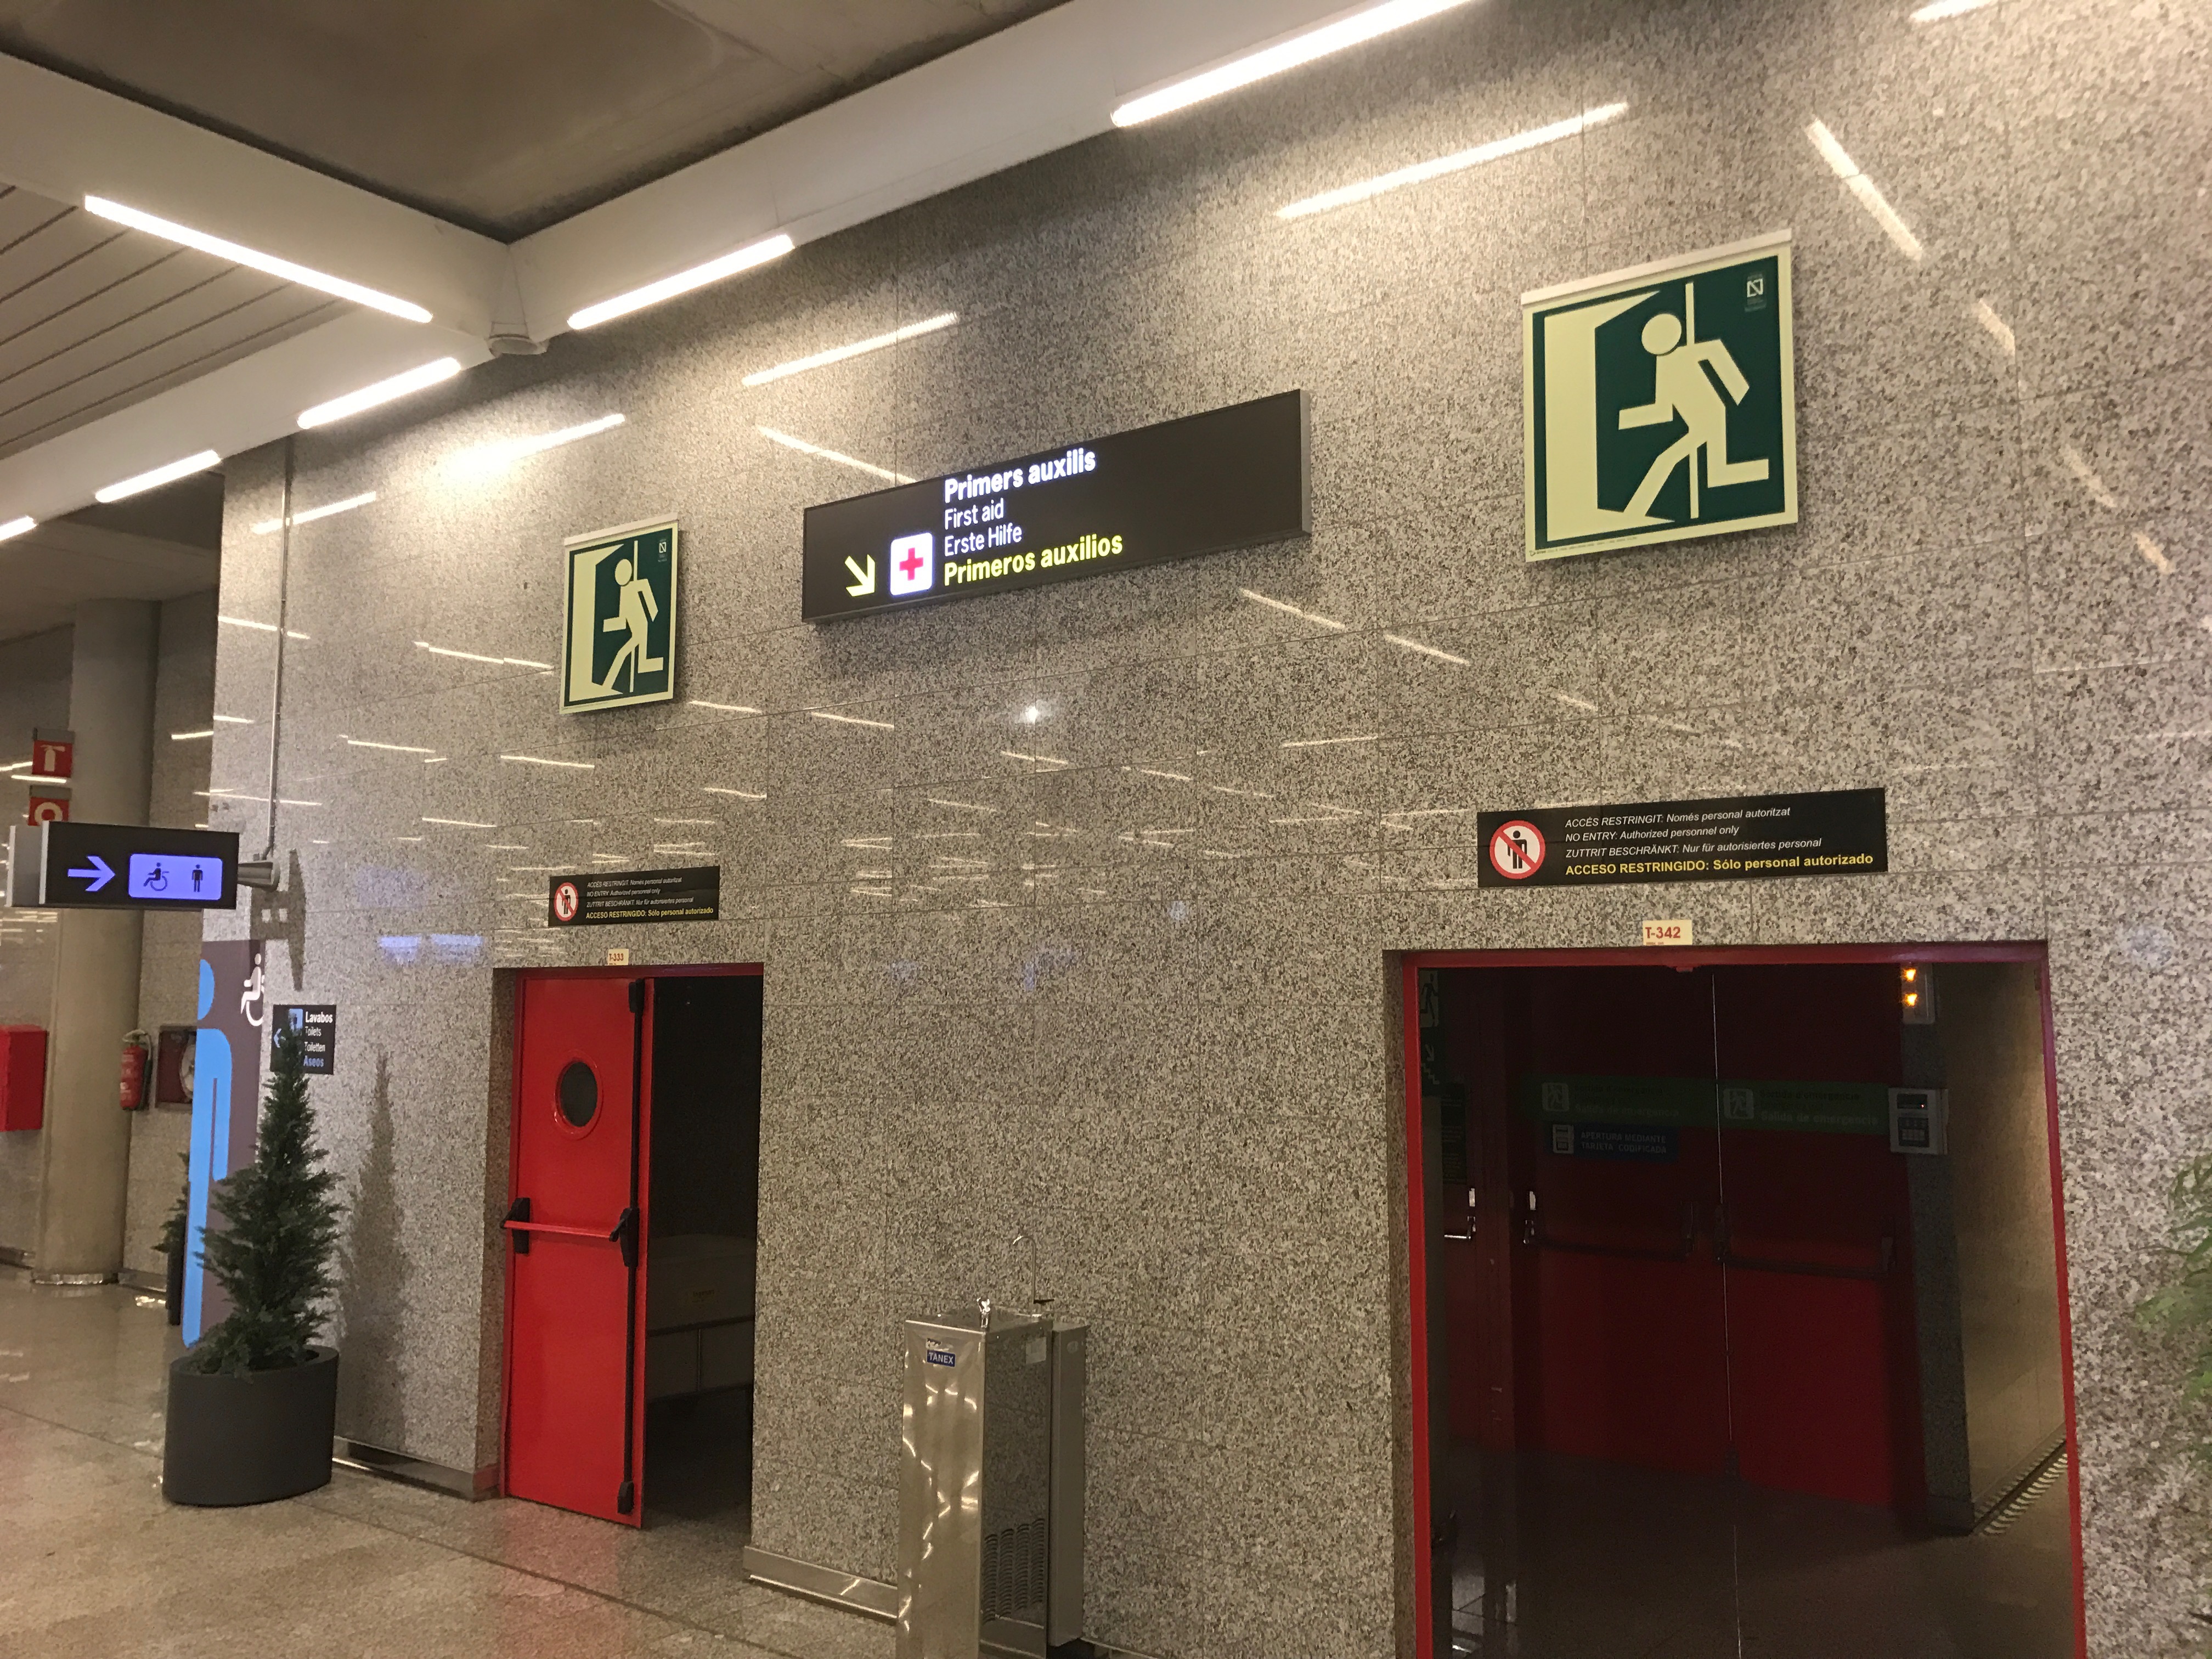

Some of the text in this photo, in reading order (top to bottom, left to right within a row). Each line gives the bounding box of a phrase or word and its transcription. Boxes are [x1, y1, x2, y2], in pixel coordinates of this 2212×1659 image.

[944, 448, 1096, 503] Primers auxilis
[945, 498, 1004, 530] First aid
[945, 522, 1023, 557] Erste Hilfe
[944, 533, 1123, 586] Primeros auxilios
[1666, 811, 1699, 823] Només
[1701, 810, 1743, 823] personal
[1745, 808, 1791, 819] autoritzat
[1565, 826, 1739, 842] NO ENTRY: Authorized personnel only
[1566, 848, 1607, 858] ZUTTRIT
[1682, 844, 1700, 853] Nur
[1702, 843, 1715, 852] für
[1717, 841, 1776, 851] autorisiertes
[1778, 838, 1822, 850] personal
[1565, 853, 1874, 875] ACCESO RESTRINGIDO: Sólo personal autorizado
[609, 910, 647, 918] RESTRINGIDO:
[648, 909, 660, 917] Sólo
[661, 908, 684, 918] personal
[1645, 926, 1681, 939] T-342
[305, 1011, 333, 1023] Lavabos
[304, 1026, 322, 1037] Toilets
[303, 1055, 324, 1068] Aseos
[1581, 1131, 1666, 1143] APERTURA MEDIANTE
[1581, 1141, 1667, 1154] TARJETA CODIFICADA
[929, 1352, 953, 1364] TANEX
